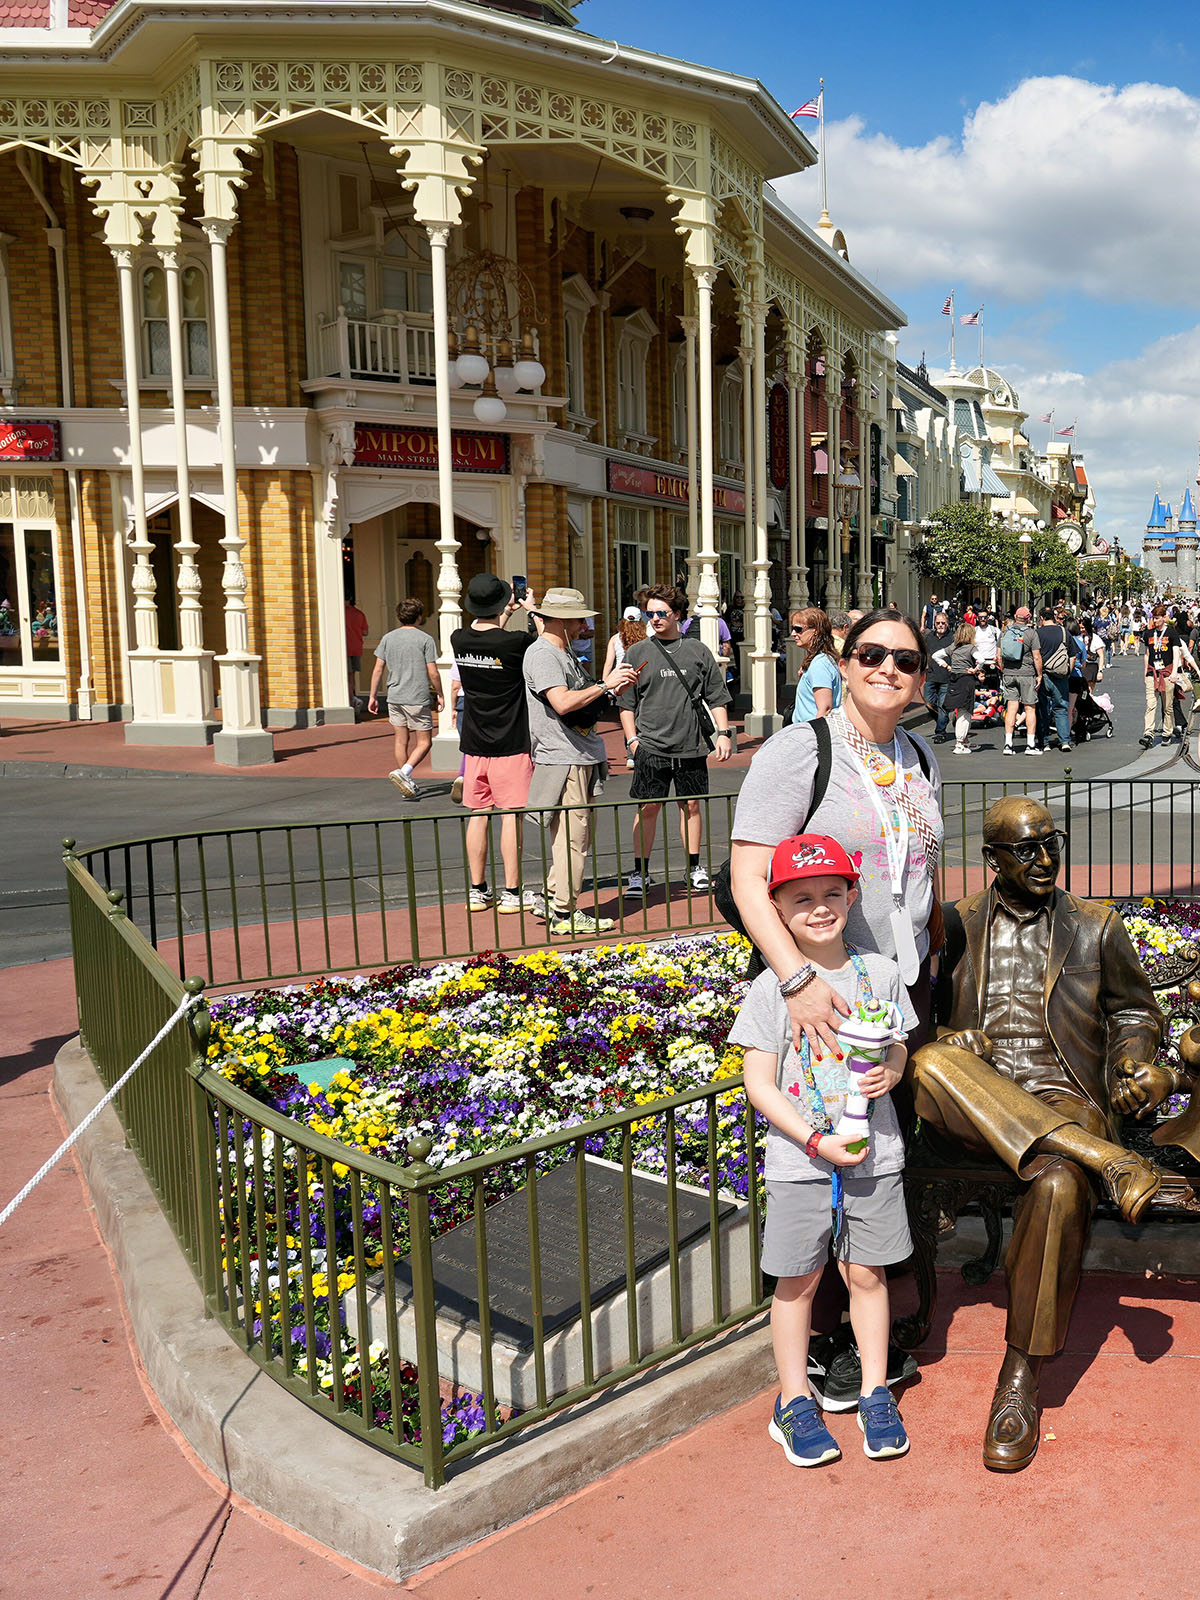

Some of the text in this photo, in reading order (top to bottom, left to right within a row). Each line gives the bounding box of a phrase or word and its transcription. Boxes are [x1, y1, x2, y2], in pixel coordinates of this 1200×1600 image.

[774, 394, 786, 478] EMPORIUM
[16, 439, 49, 449] & Toys
[377, 453, 405, 462] MAIN
[407, 455, 438, 464] STREE
